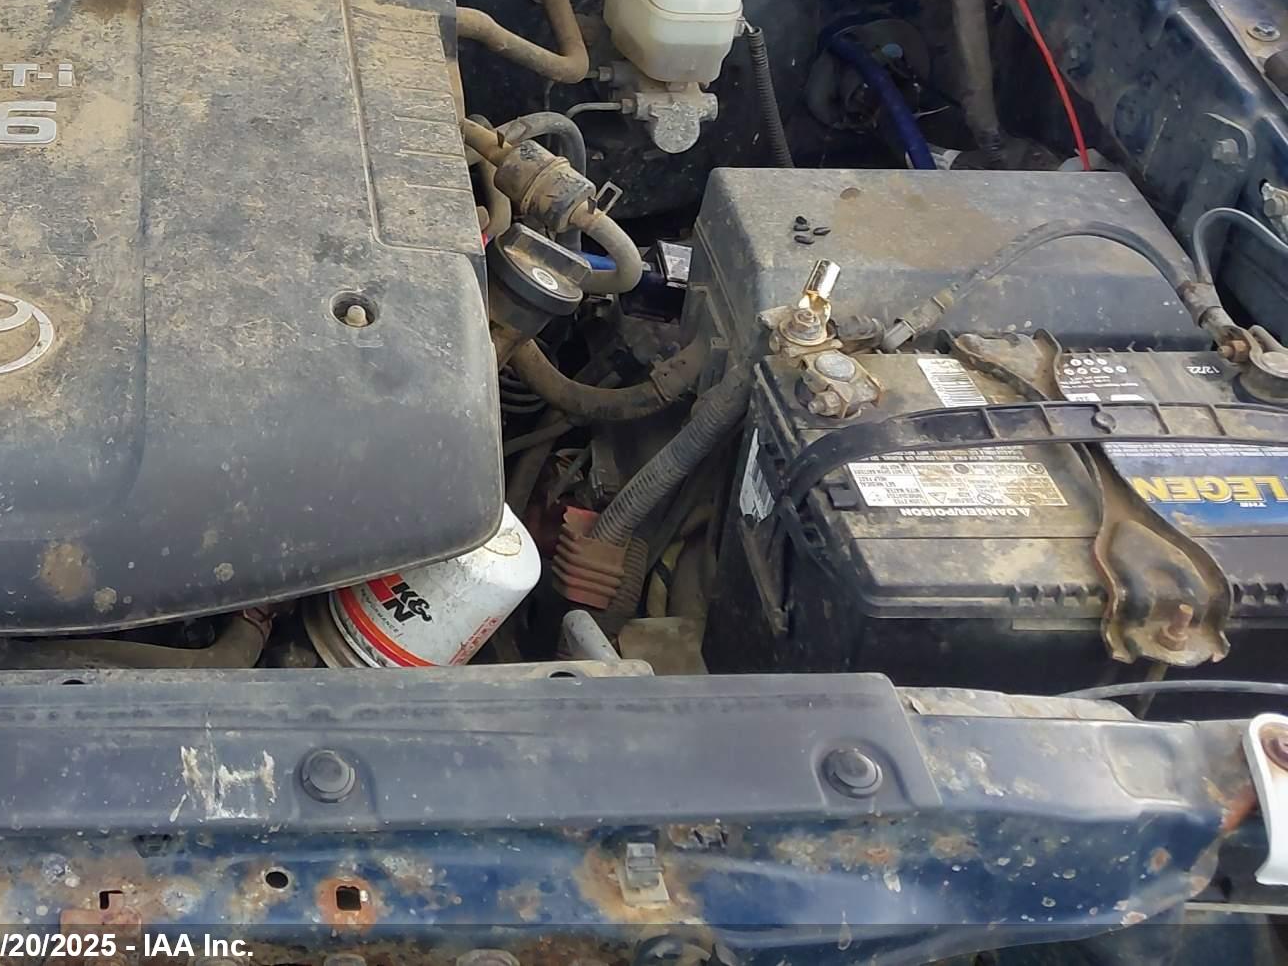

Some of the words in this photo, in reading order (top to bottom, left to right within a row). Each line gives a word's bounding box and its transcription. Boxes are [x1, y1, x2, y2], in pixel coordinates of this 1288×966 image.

[1132, 475, 1288, 503] LEGEN
[899, 508, 1018, 516] DANGER/POISON
[382, 582, 432, 623] K&N
